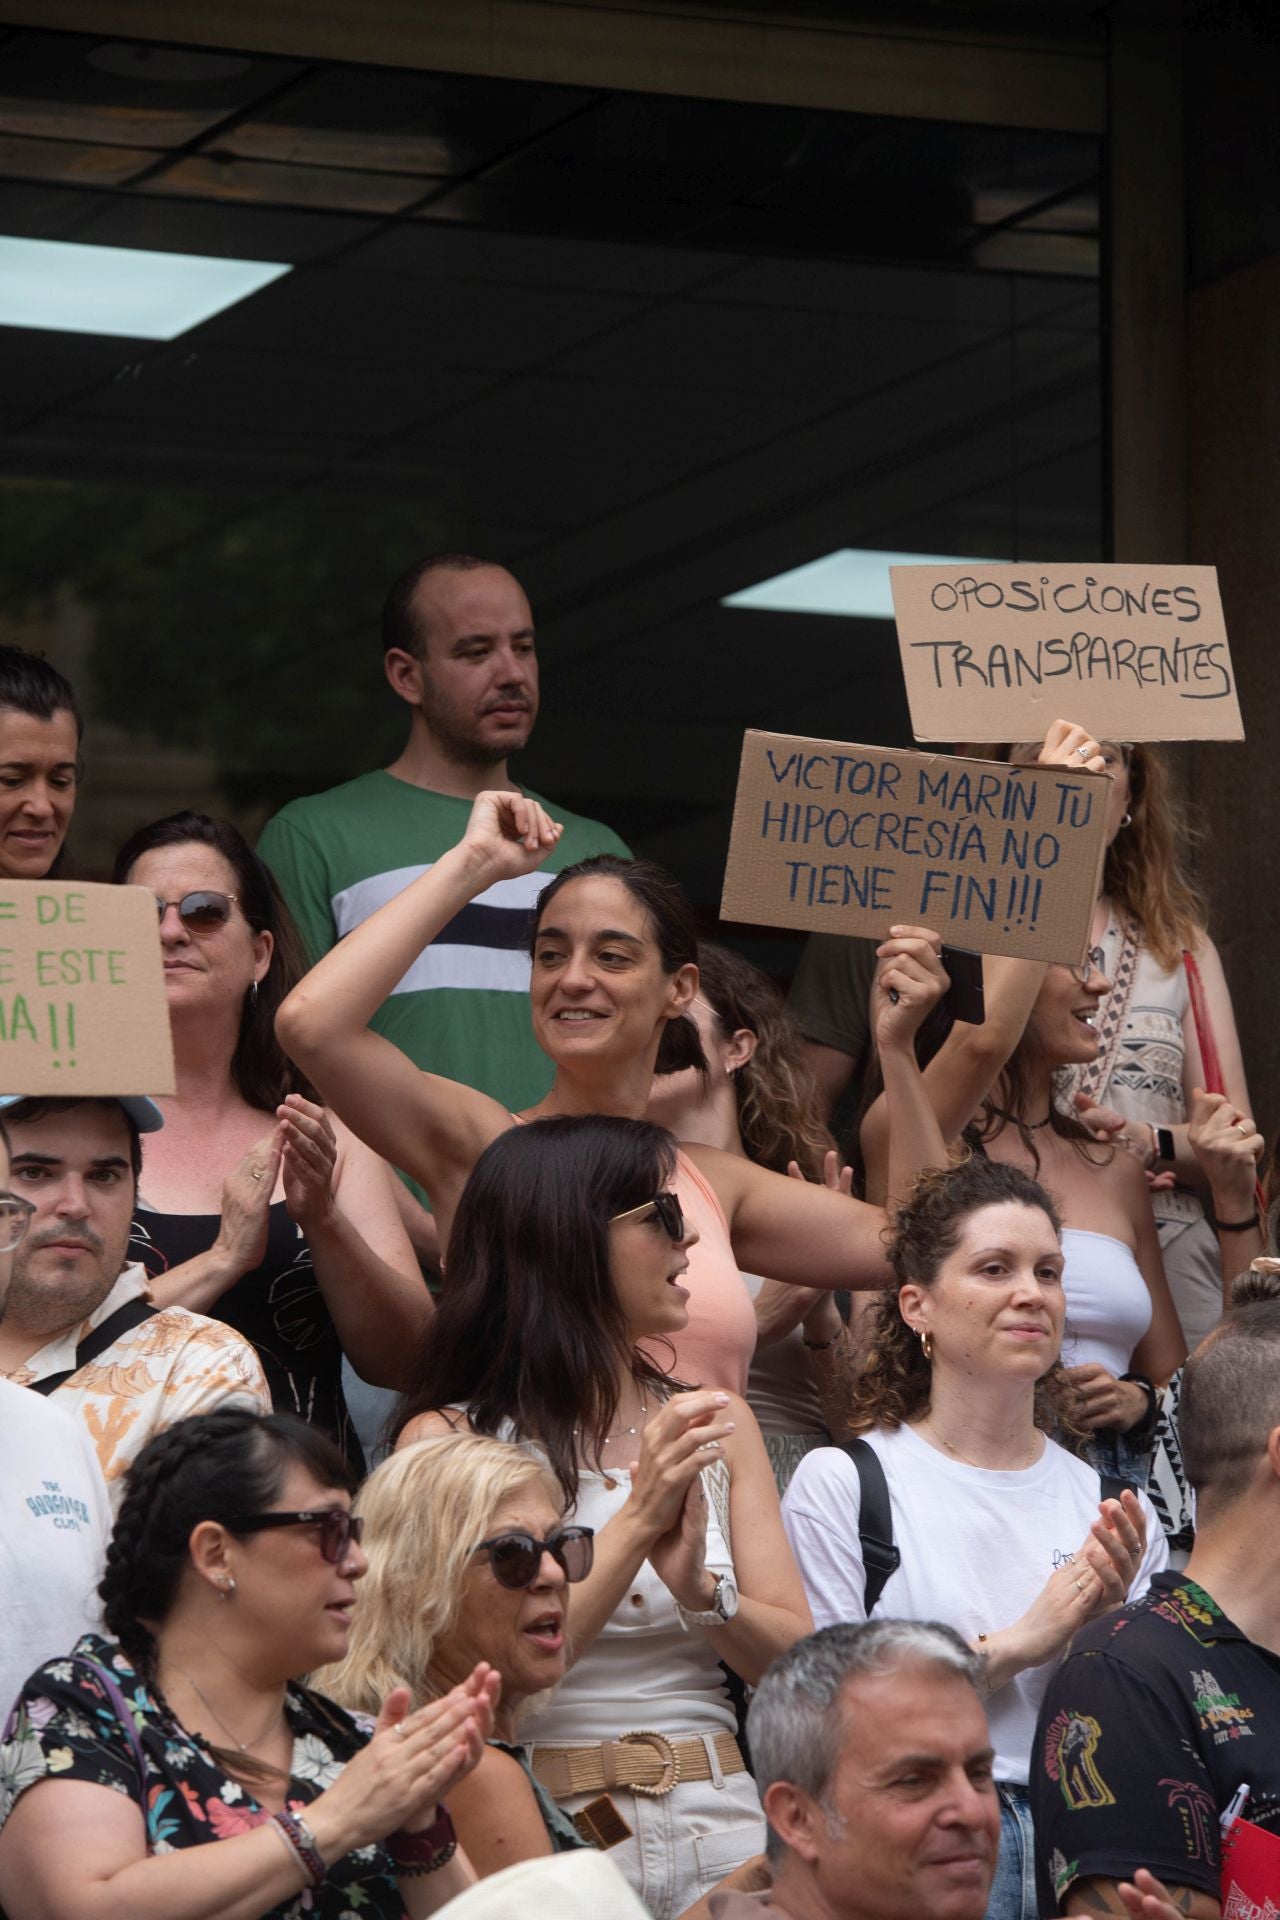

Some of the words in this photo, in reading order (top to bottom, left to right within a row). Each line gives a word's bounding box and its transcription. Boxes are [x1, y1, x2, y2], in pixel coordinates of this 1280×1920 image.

[911, 632, 1231, 699] TRANSPARENTES
[766, 750, 901, 800] VICTOR
[917, 770, 1037, 821] MARÍN
[1055, 783, 1092, 828] TU
[761, 801, 987, 863] HIPOCRESÍA
[1001, 829, 1060, 870] NO
[36, 893, 87, 925] DE
[785, 862, 896, 910] TIENE
[920, 870, 1043, 932] FIN!!!
[36, 949, 127, 987] ESTE
